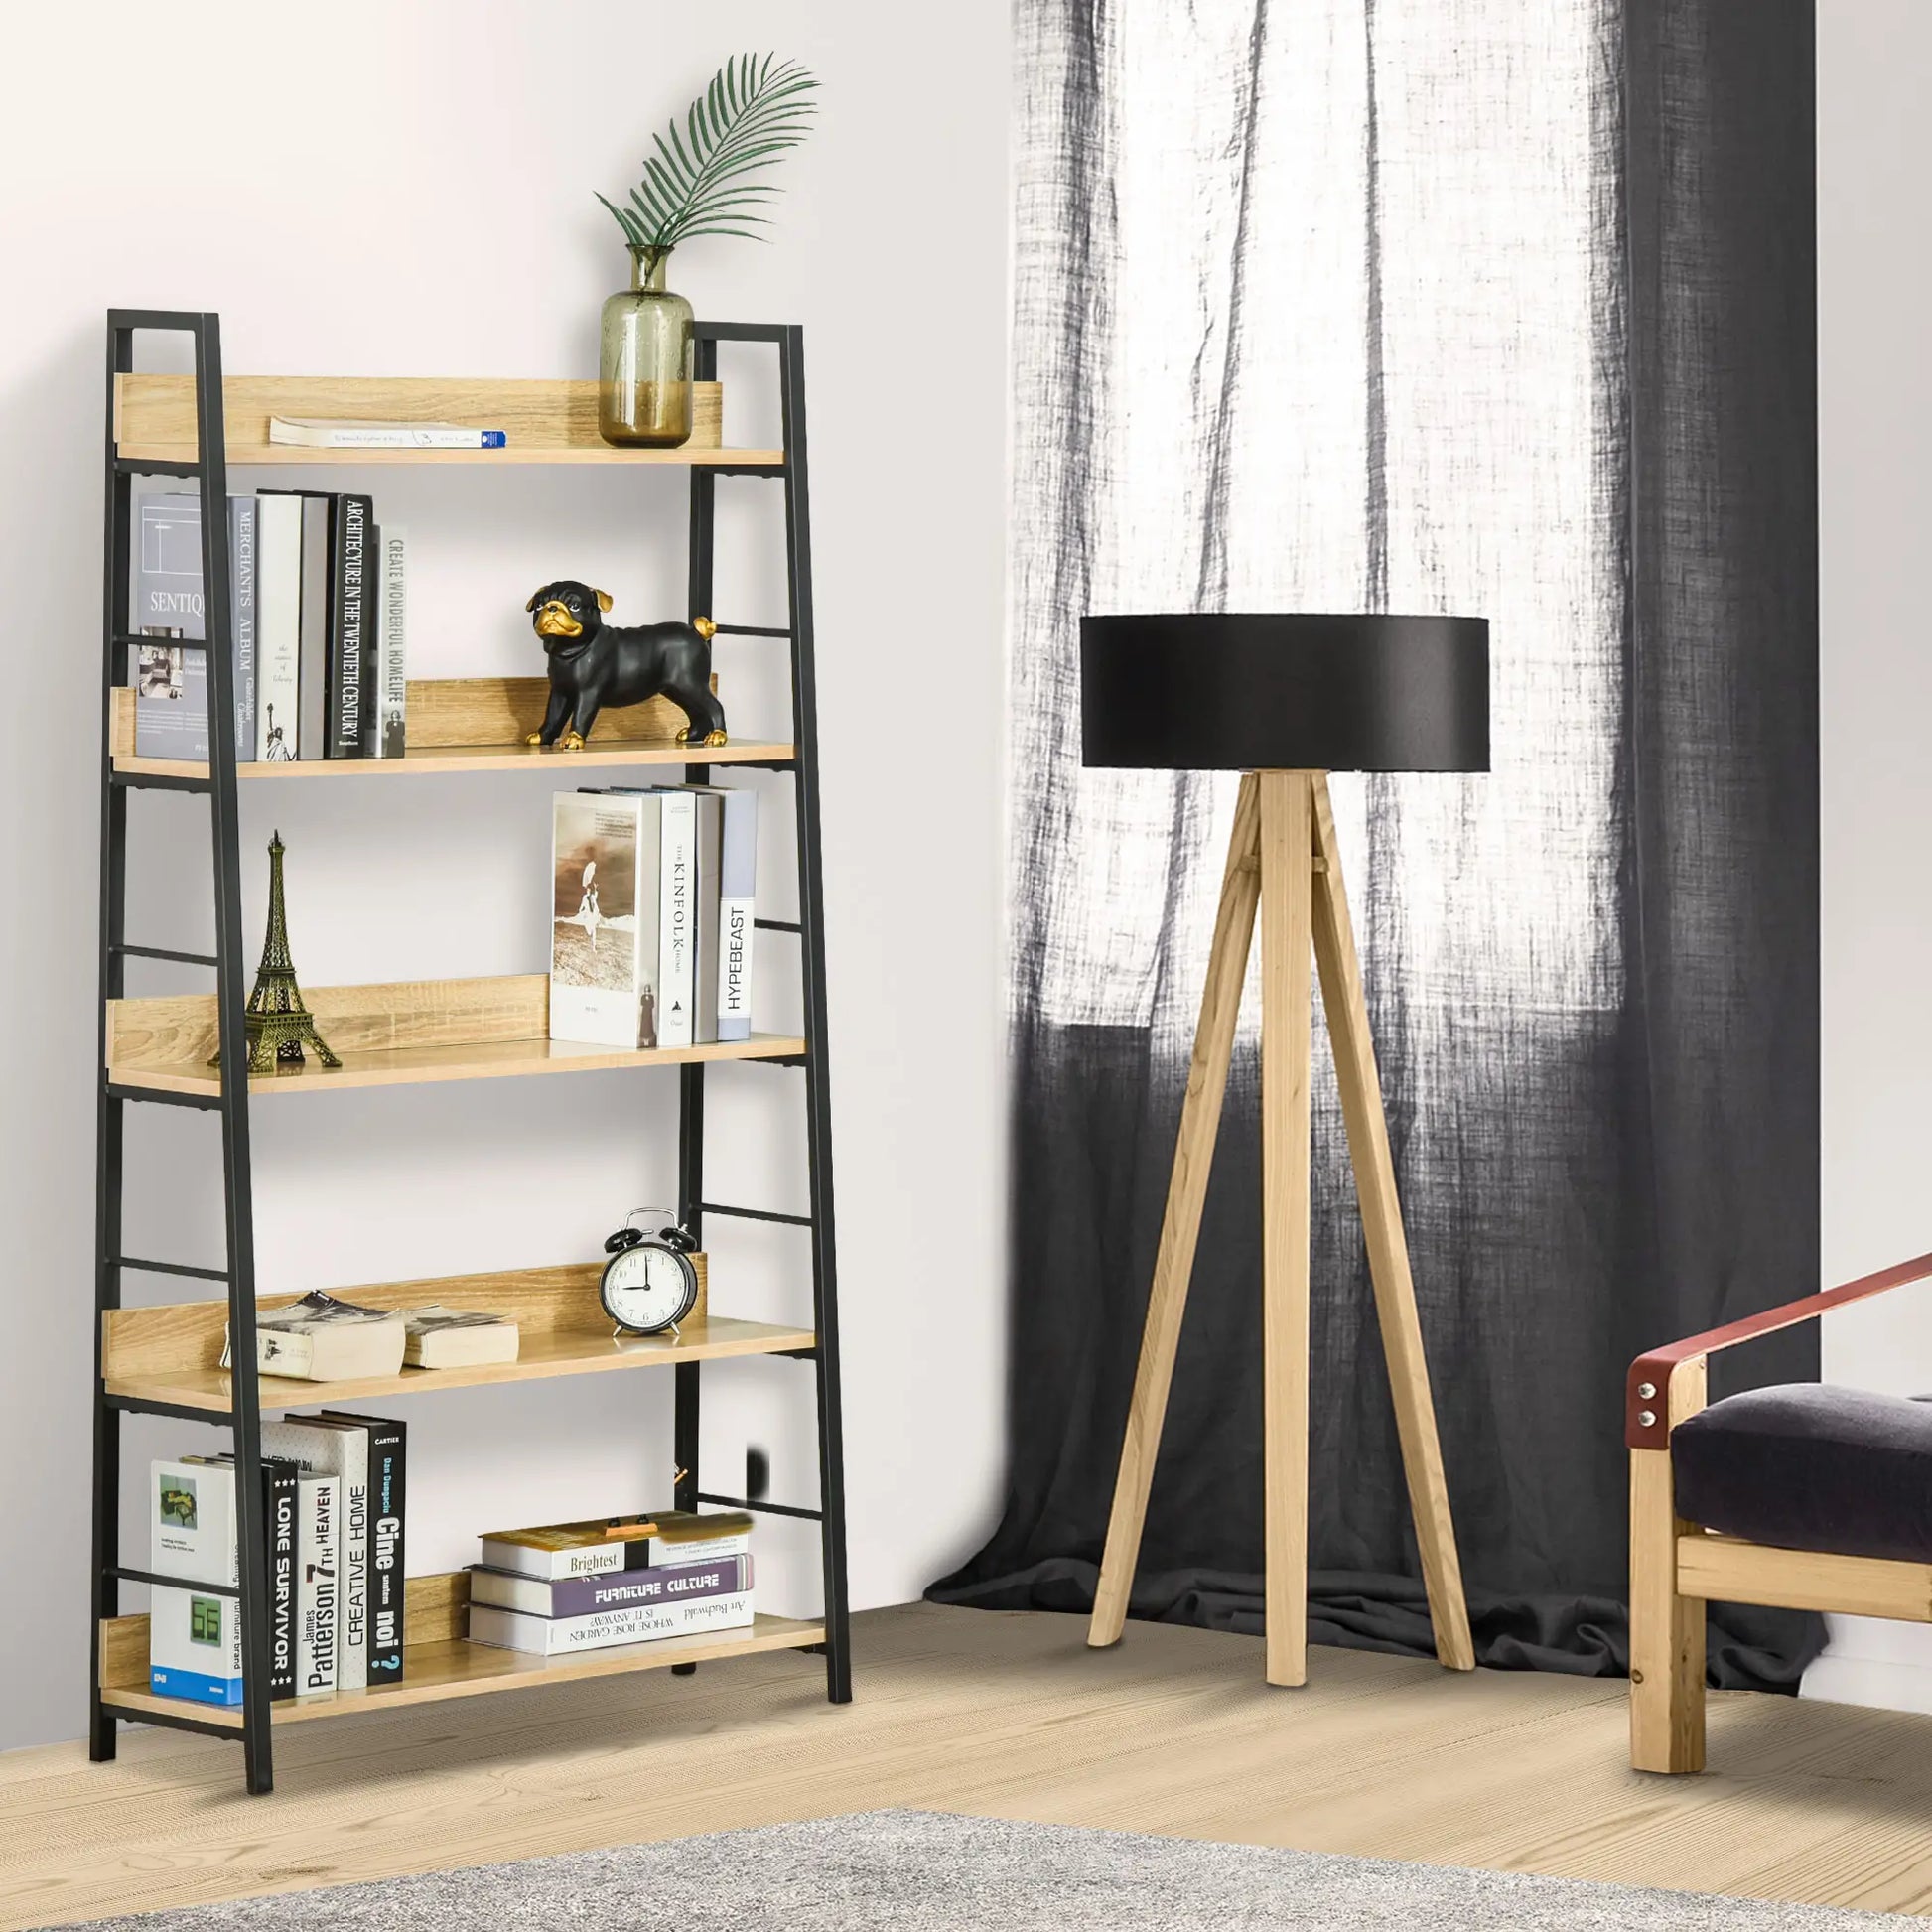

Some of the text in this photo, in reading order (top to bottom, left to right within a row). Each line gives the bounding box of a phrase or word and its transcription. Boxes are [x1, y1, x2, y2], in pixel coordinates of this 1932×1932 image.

[151, 591, 205, 617] SENTIQ
[239, 511, 251, 670] MERCHANTS ALBUM
[345, 586, 361, 598] IN
[345, 600, 361, 621] THE
[388, 539, 404, 702] CREATE WONDERFUL HOMELIFE
[343, 622, 360, 684] TWENTIETH
[341, 687, 359, 738] CENTURY
[673, 863, 685, 950] KINFOLK
[728, 906, 745, 1010] HYPEBEAST
[383, 1457, 392, 1474] Dan
[316, 1487, 331, 1545] HEAVEN
[348, 1485, 365, 1646] CREATIVE HOME
[375, 1516, 400, 1570] Cine
[570, 1552, 618, 1573] Brightest
[273, 1496, 292, 1671] LONE SURVIVOR
[595, 1573, 720, 1604] FURNITURE CULTURE
[303, 1610, 315, 1644] James
[308, 1583, 335, 1688] Patterson
[376, 1611, 399, 1649] noi
[569, 1627, 611, 1642] GARDEN
[612, 1623, 636, 1636] ROSE
